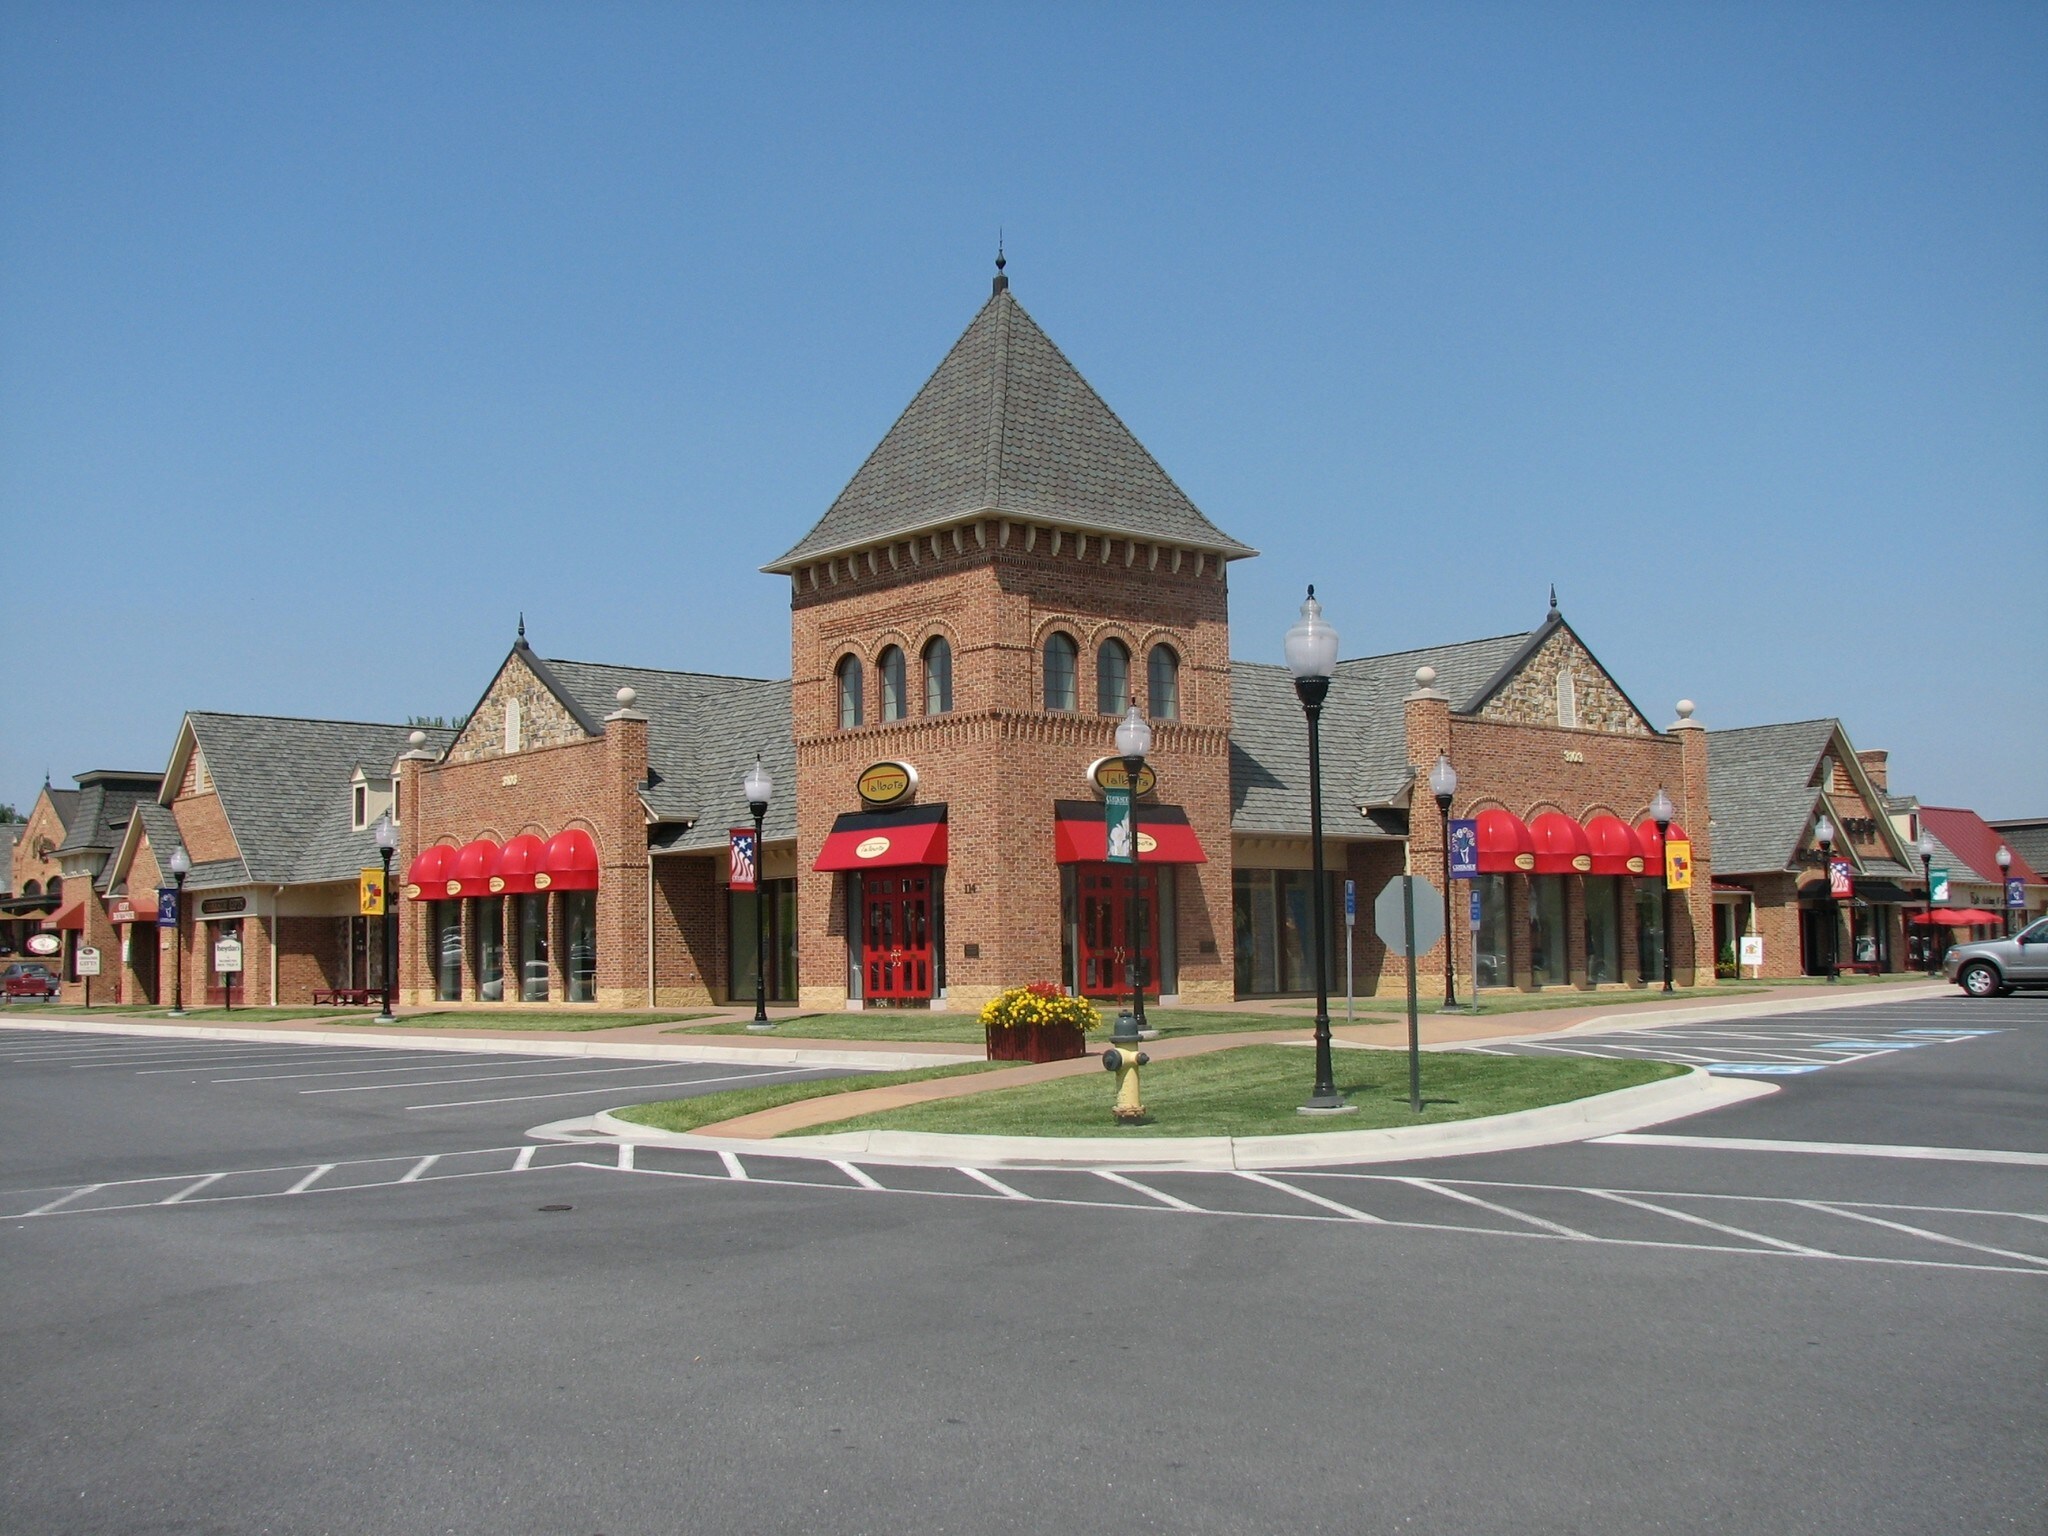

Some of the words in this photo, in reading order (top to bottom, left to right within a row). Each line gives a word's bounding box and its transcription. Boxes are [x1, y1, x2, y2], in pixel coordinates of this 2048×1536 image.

[862, 773, 905, 792] Talbots
[1100, 769, 1151, 787] Talbts
[860, 842, 888, 853] Talbots
